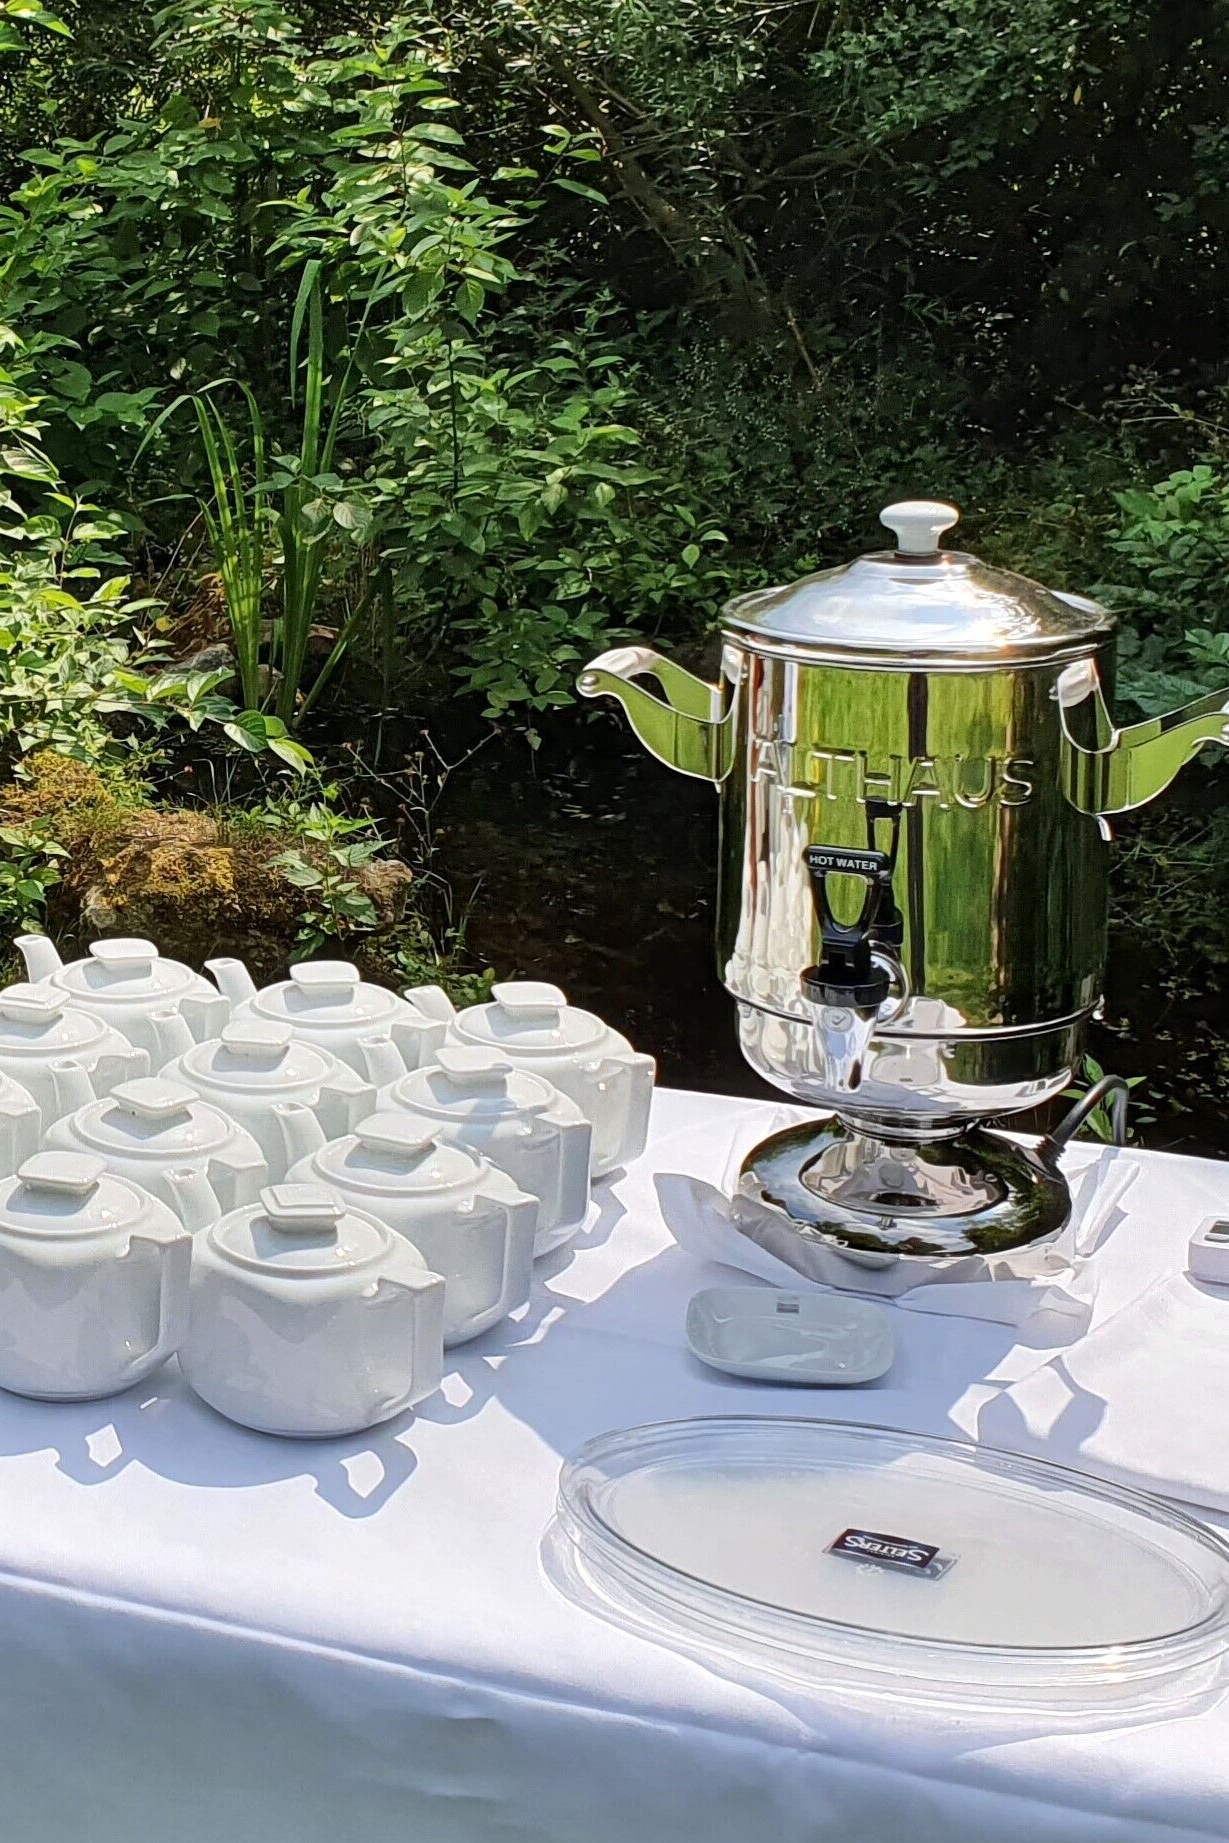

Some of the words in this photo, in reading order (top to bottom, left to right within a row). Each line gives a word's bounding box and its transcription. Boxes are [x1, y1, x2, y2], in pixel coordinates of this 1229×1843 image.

[751, 739, 1035, 809] ALTHAUS
[809, 854, 834, 866] HOT
[835, 857, 878, 871] WATER
[843, 1534, 930, 1562] SELTERS
